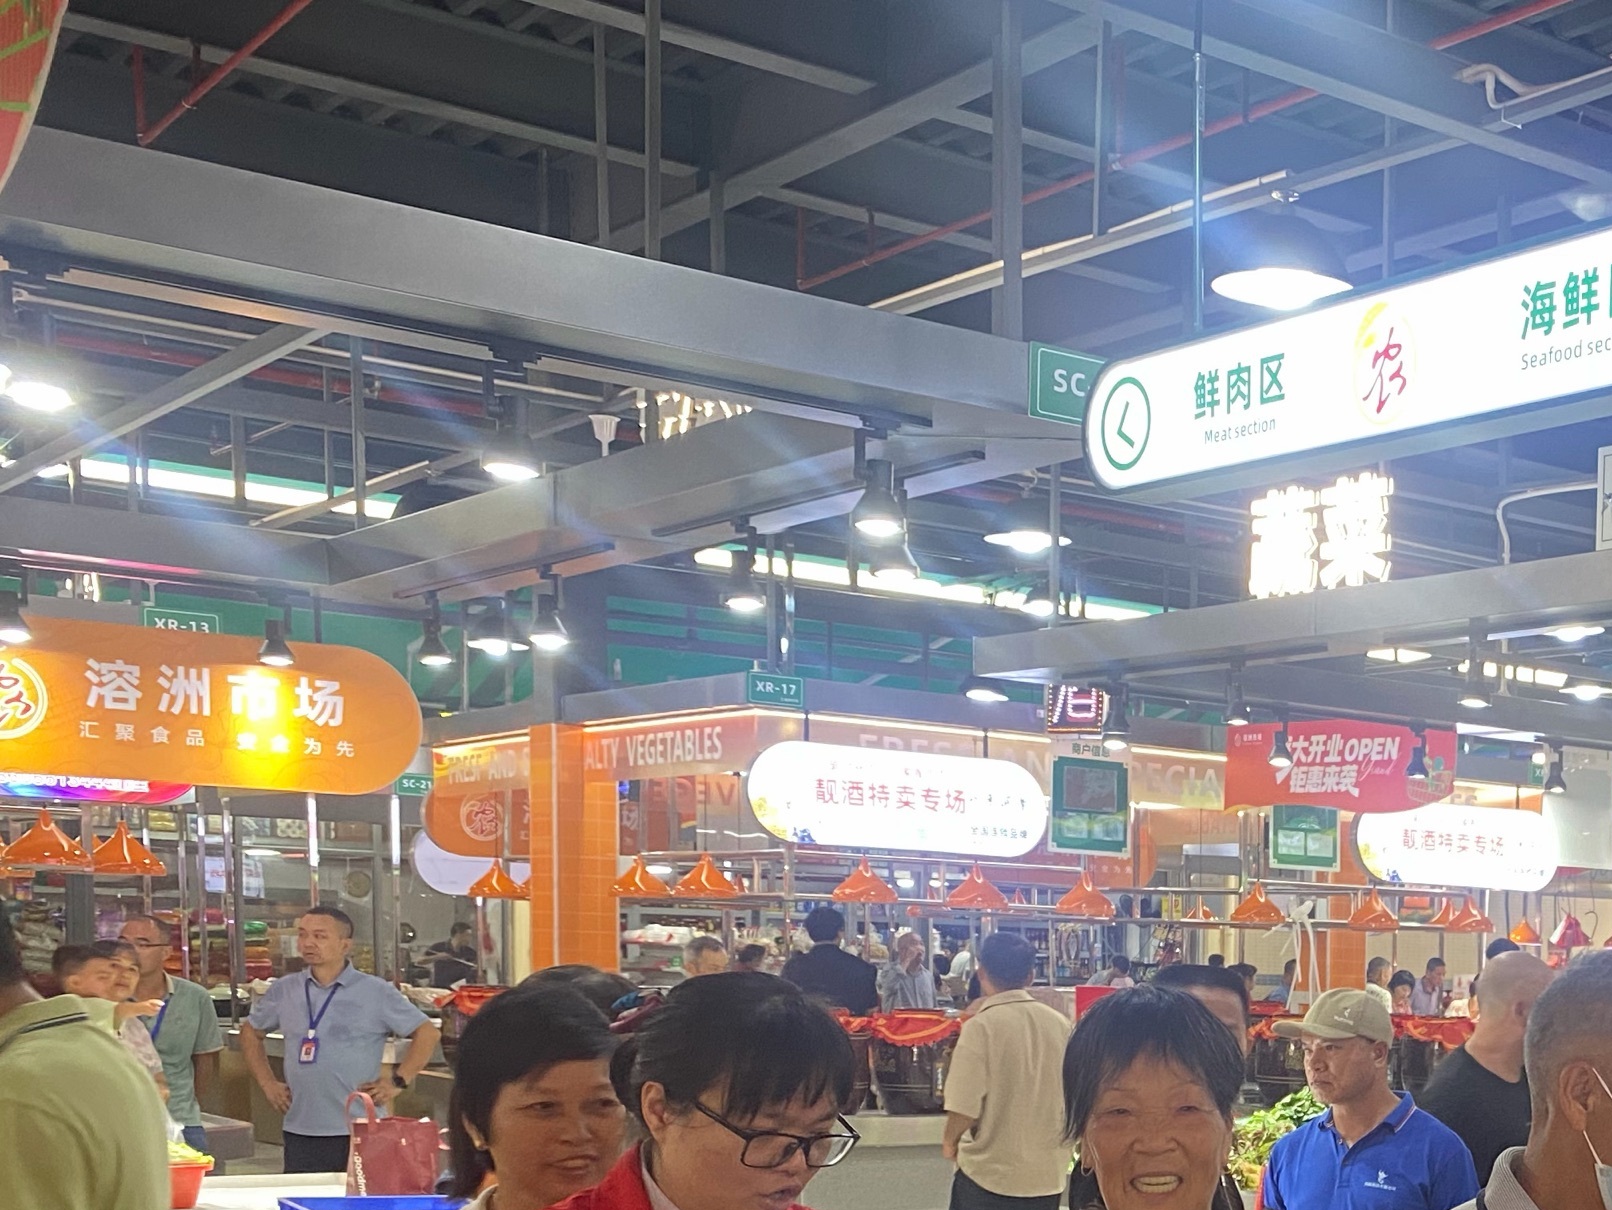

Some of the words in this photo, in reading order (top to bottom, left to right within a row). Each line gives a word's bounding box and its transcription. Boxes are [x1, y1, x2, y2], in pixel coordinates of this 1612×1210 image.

[1521, 339, 1583, 370] Seafood
[1194, 353, 1286, 420] 鲜肉区
[1204, 427, 1232, 444] Meat
[1235, 418, 1276, 438] section
[154, 617, 210, 633] XR-13
[84, 658, 345, 728] 溶洲市场
[756, 680, 796, 695] XR-17
[79, 719, 205, 748] 汇聚食品
[626, 725, 723, 767] VEGETABLES
[1275, 733, 1343, 785] 大开业
[1344, 736, 1401, 762] OPEN
[402, 779, 432, 790] SC-21
[815, 778, 966, 814] 靓酒特卖专场
[1290, 764, 1360, 797] 钜惠来袭
